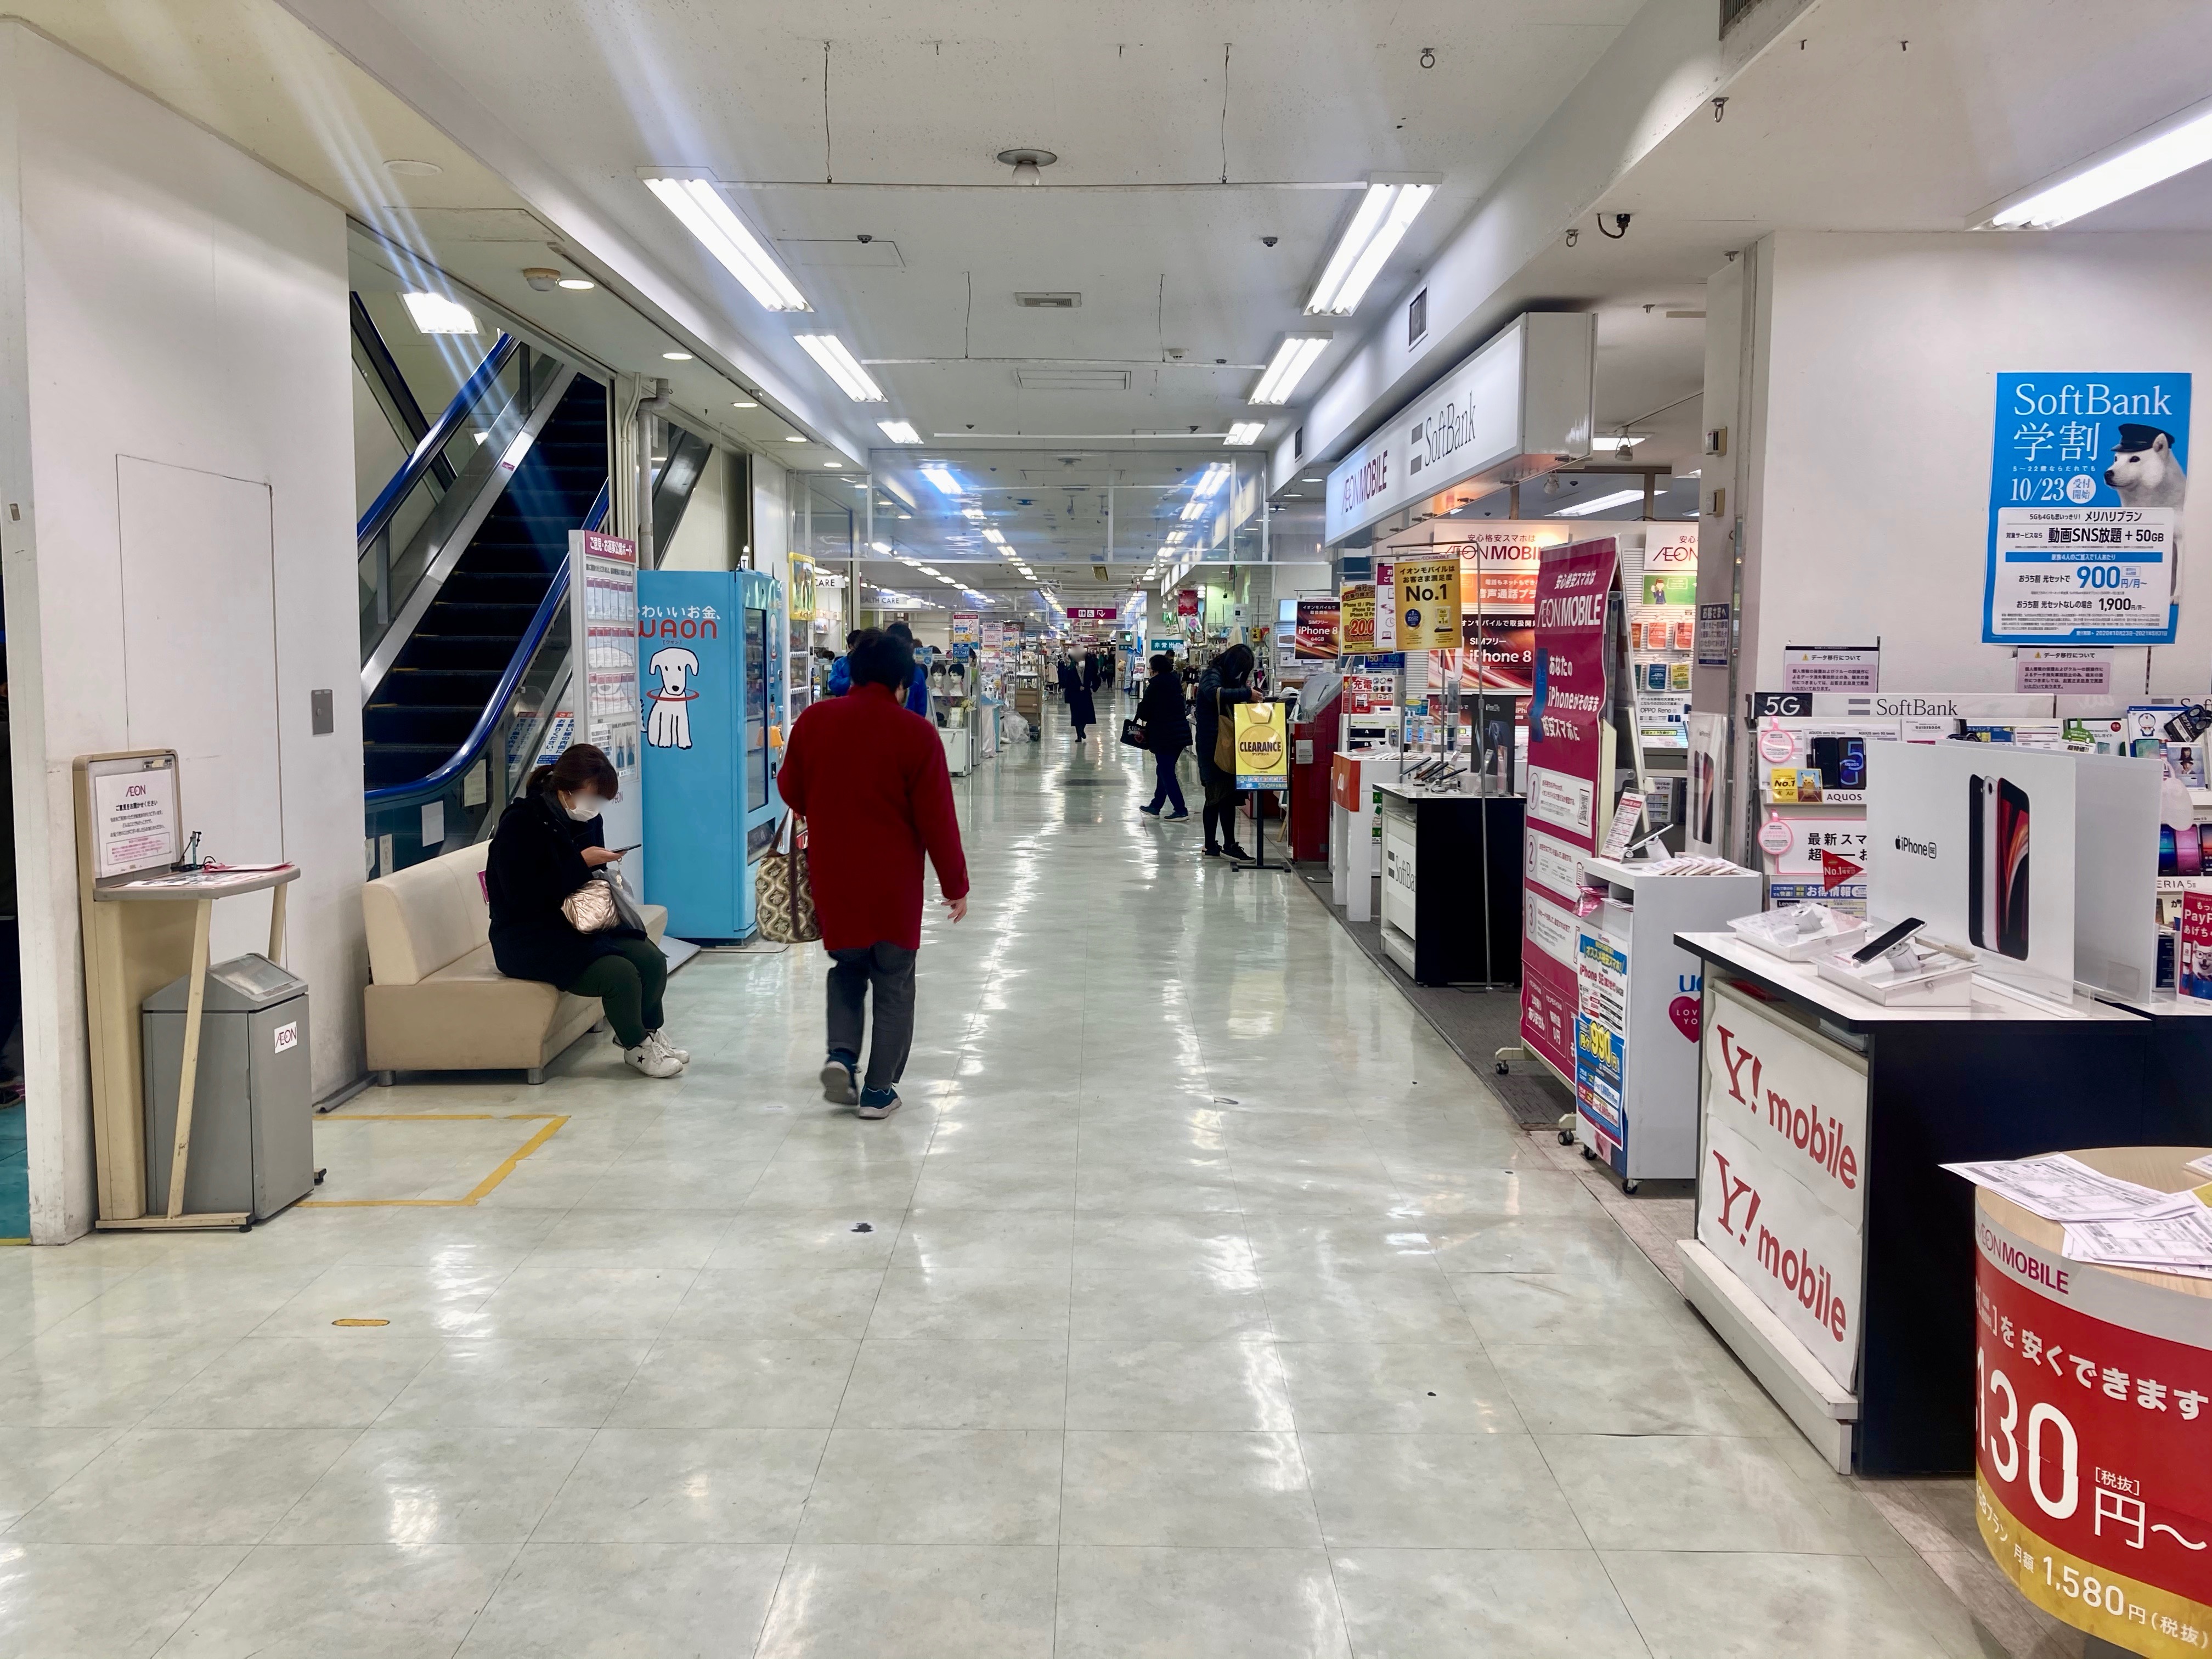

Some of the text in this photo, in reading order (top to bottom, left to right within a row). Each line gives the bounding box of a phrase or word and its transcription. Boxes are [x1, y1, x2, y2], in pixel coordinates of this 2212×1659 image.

[2014, 383, 2172, 415] SoftBank
[1425, 390, 1476, 467] SoftBank
[2014, 421, 2101, 462] 学割
[2010, 477, 2065, 501] 10/23
[2073, 478, 2090, 489] 受付
[2072, 489, 2090, 500] 開始
[2085, 511, 2142, 522] メリハリプラン
[1468, 534, 1536, 543] 安心格安スマホは
[2048, 527, 2122, 543] 動画SNS放題
[2136, 529, 2164, 542] 50GB
[1400, 565, 1455, 575] イオンモバイルは
[1402, 574, 1453, 583] お客さま満足度
[1554, 570, 1596, 589] 安心格安スマホは
[2018, 575, 2041, 583] おうち割
[1406, 584, 1447, 602] No.1
[2016, 600, 2039, 609] おうち割
[638, 605, 721, 620] わいいお金、
[639, 618, 718, 639] WAON
[1299, 626, 1338, 635] iPhone 8
[1522, 650, 1532, 663] 8
[1549, 655, 1573, 676] あなたの
[1353, 680, 1373, 690] 充電
[1548, 685, 1600, 712] iPhoneがそのまま
[1763, 696, 1801, 716] 5G
[1876, 698, 1959, 716] SoftBank
[1239, 741, 1282, 752] CLEARANCE
[1826, 793, 1863, 802] AQUOS
[1901, 837, 1928, 856] iPhone
[2014, 1543, 2034, 1574] 月額
